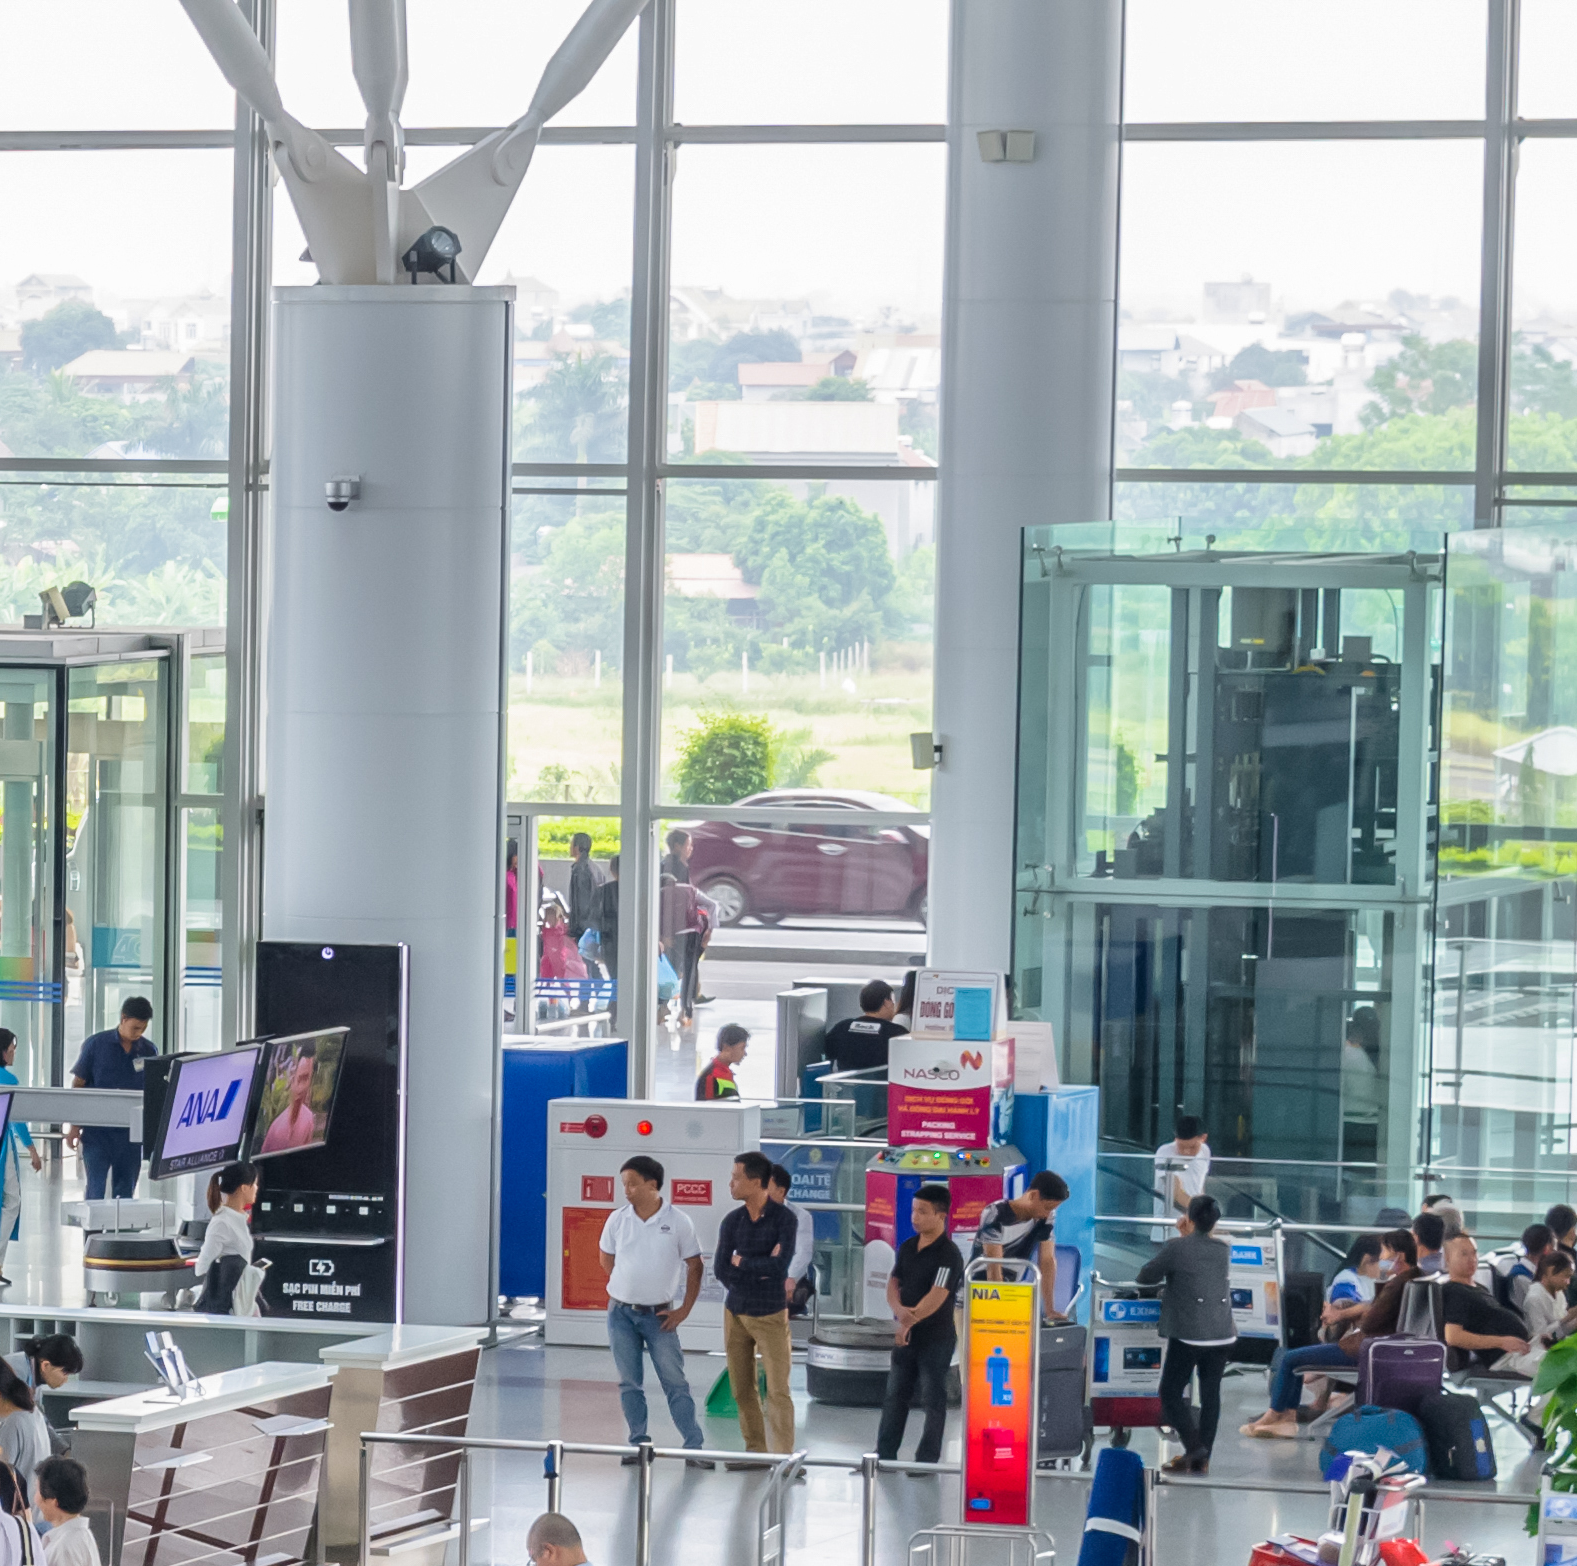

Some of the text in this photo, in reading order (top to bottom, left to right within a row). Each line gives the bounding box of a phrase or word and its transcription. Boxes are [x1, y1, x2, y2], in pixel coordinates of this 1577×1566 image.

[904, 1067, 960, 1081] NASCO
[176, 1088, 220, 1130] ANA
[922, 1121, 955, 1129] PACKING
[901, 1130, 976, 1140] STRAPPING SERVICE
[186, 1150, 218, 1167] ALLIANCE
[676, 1183, 706, 1195] PCCC
[788, 1188, 831, 1200] CHANGE
[283, 1283, 300, 1296] SẠC
[303, 1284, 318, 1295] PIN
[973, 1288, 1000, 1300] NIA
[293, 1300, 351, 1313] FREE CHARGE
